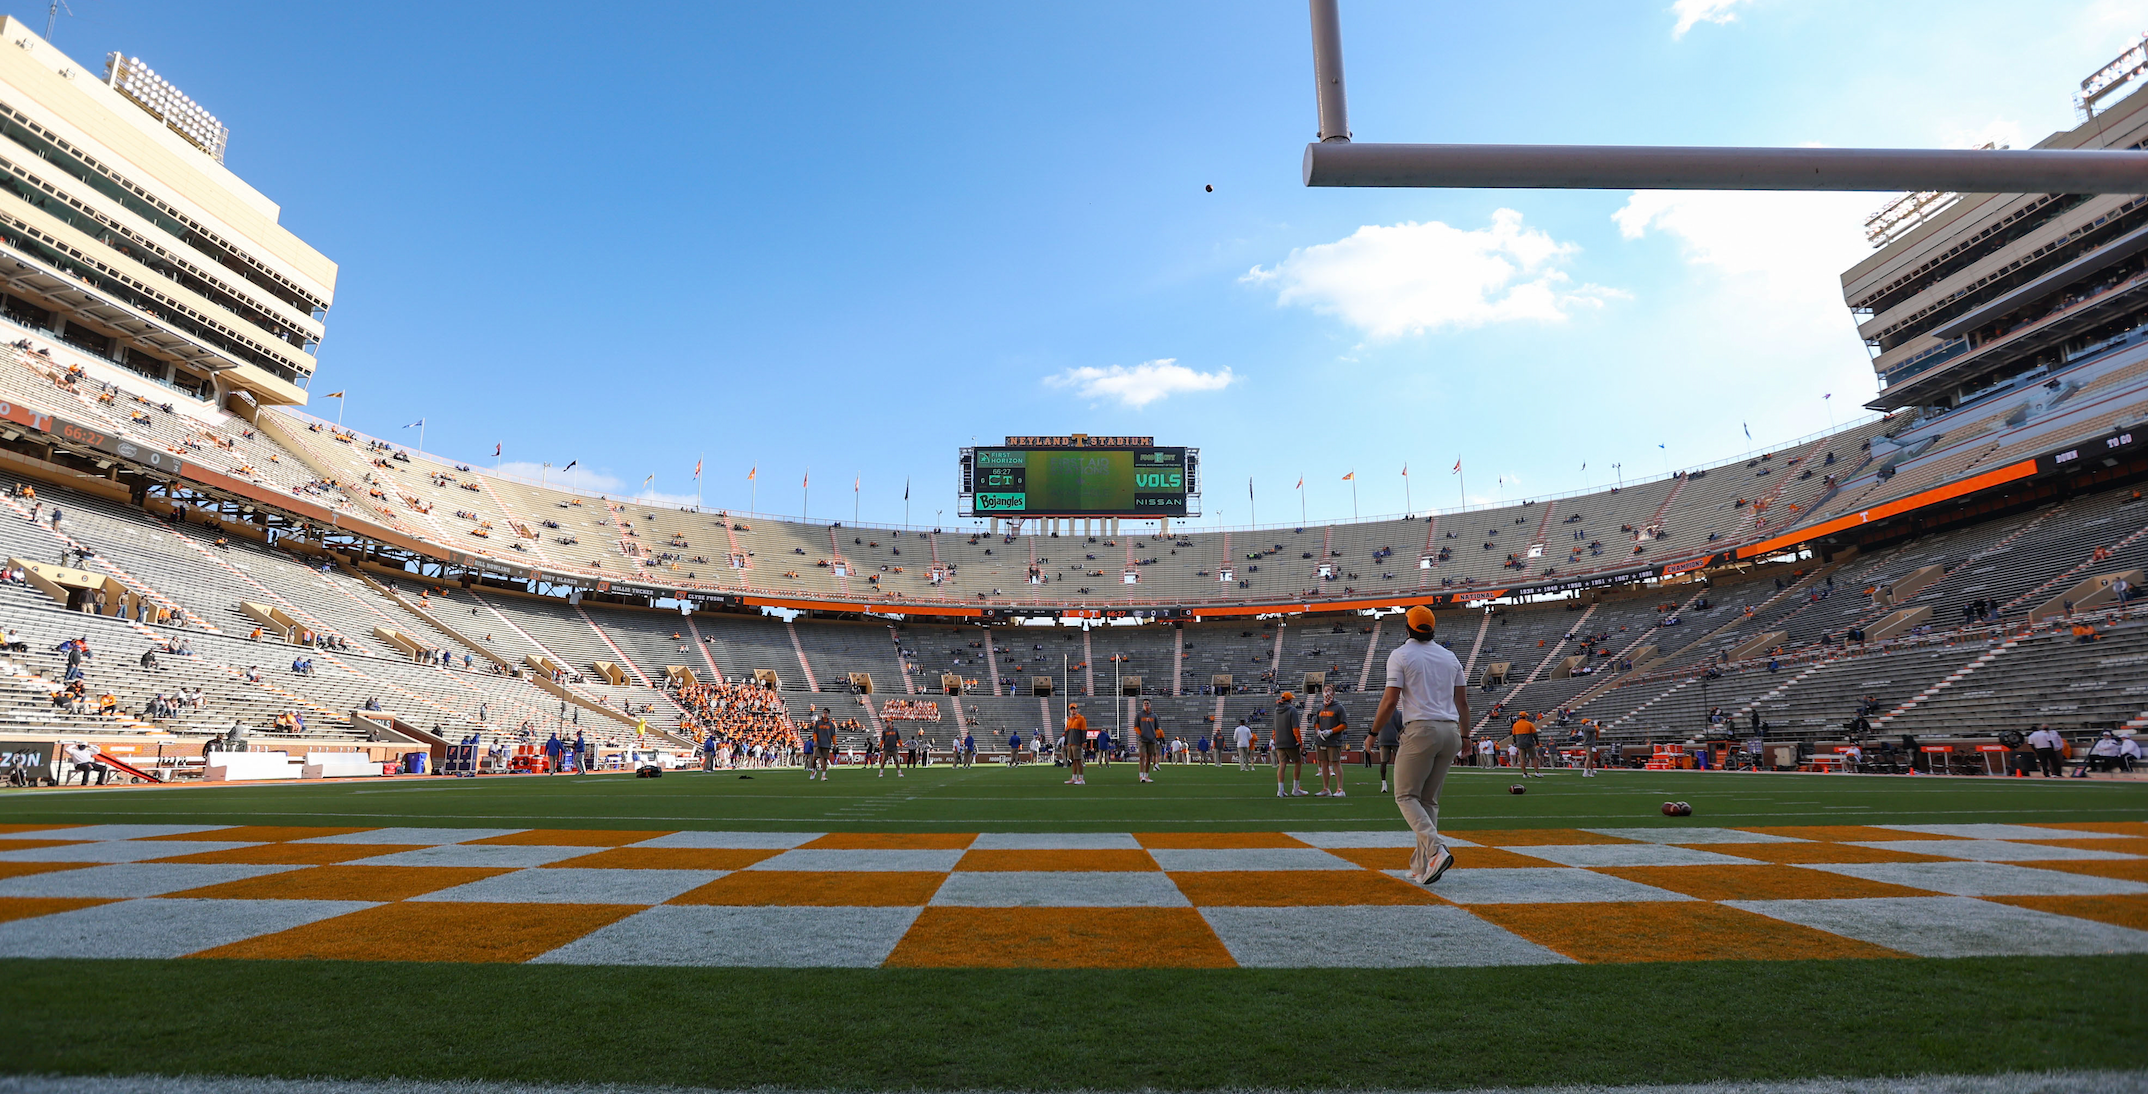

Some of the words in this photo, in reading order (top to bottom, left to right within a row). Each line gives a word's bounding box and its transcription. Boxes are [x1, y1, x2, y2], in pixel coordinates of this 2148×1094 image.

[64, 425, 105, 446] 66:27
[1009, 437, 1069, 446] NEYLAND
[1090, 437, 1150, 446] STADIUM
[2106, 437, 2120, 449] TO
[2120, 433, 2133, 445] GO
[1135, 473, 1182, 488] VOLS
[979, 494, 1023, 509] Bojangles
[1667, 560, 1704, 573] CHAMPIONS
[611, 585, 631, 593] WILLIS
[632, 587, 654, 596] TUCKER
[1460, 592, 1495, 600] NATIONAL
